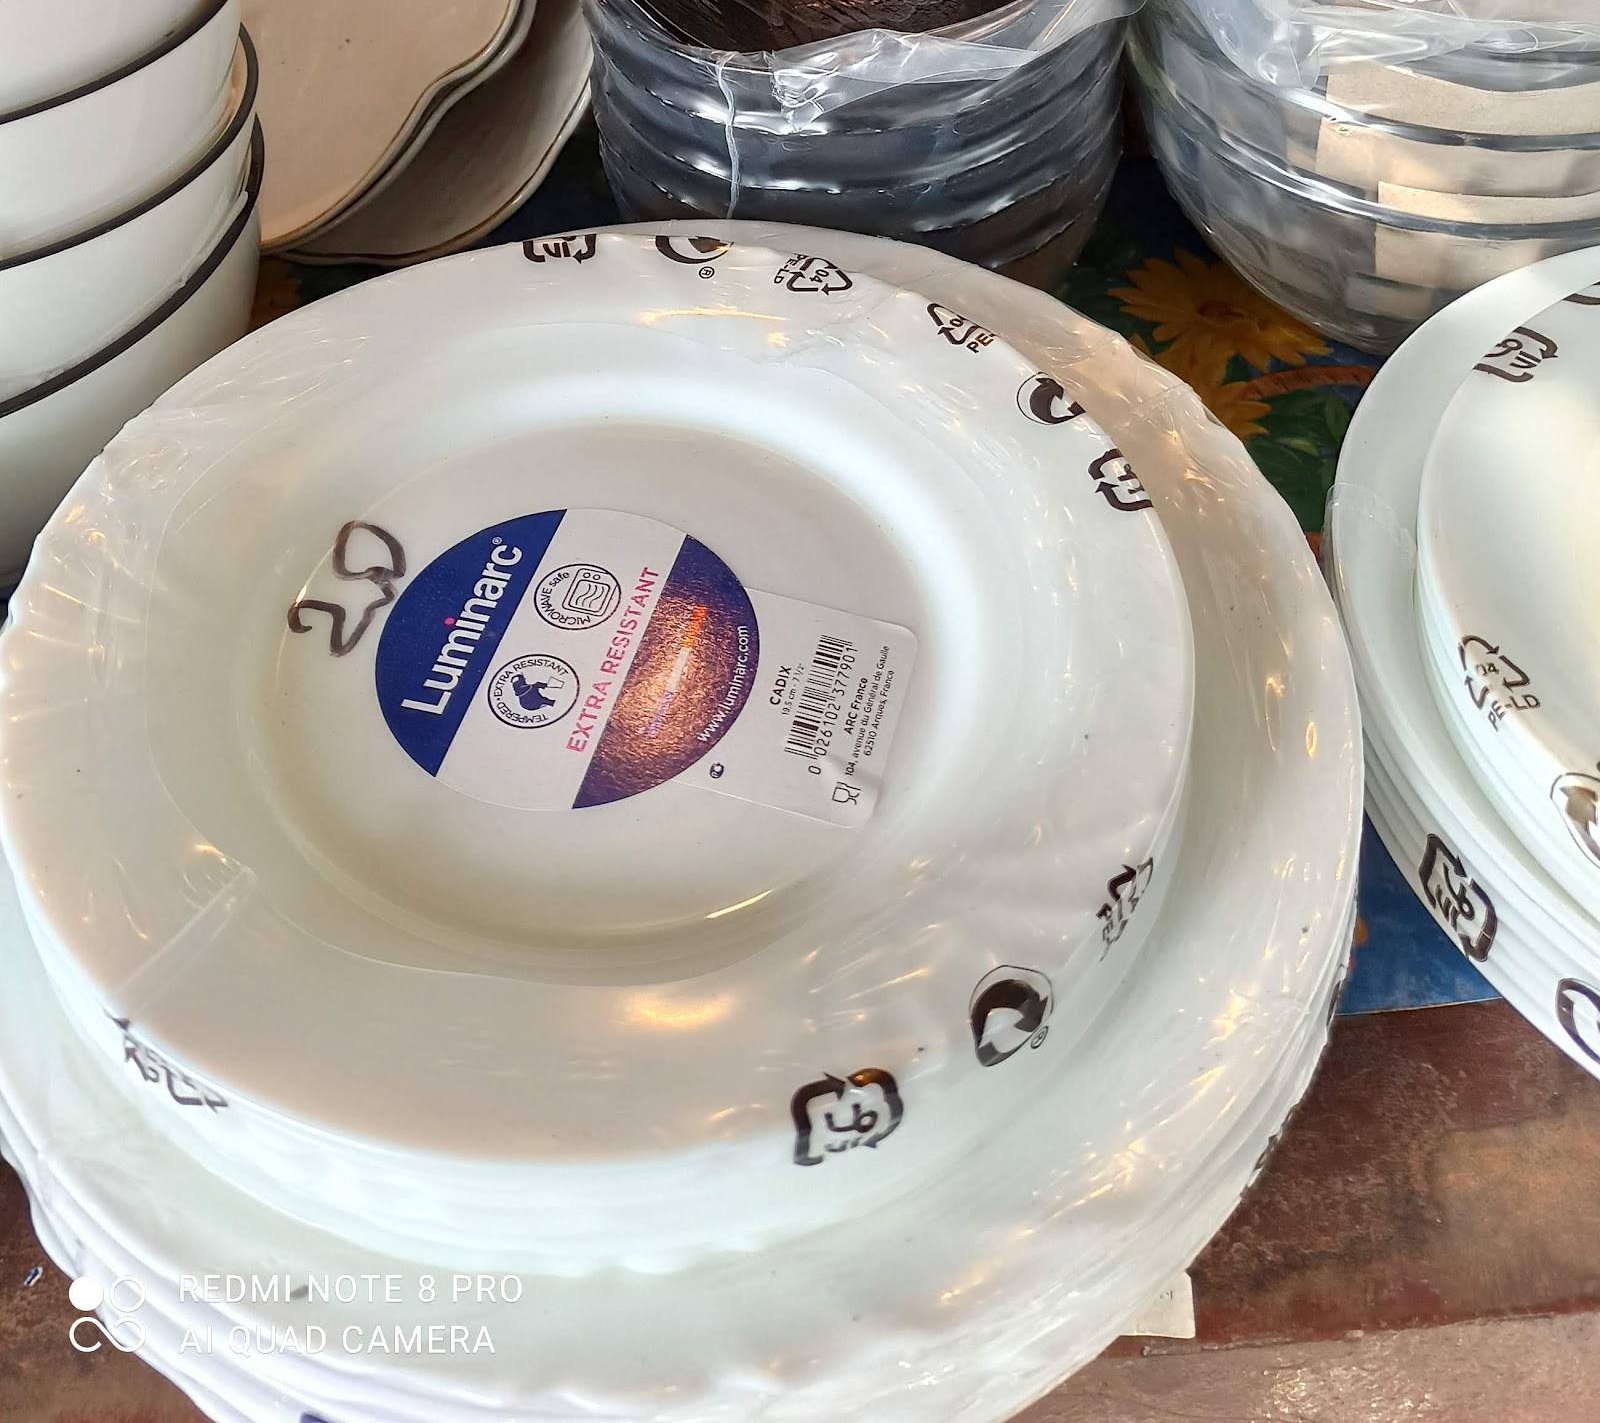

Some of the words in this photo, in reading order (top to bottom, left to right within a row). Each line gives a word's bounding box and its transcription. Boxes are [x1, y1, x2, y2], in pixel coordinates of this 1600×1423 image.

[288, 520, 406, 657] 20
[549, 572, 570, 587] safe
[540, 587, 591, 625] MICROWAVE
[513, 658, 569, 676] RESISTANT
[566, 681, 612, 754] EXTRA
[607, 566, 659, 676] RESISTANT
[831, 644, 858, 697] 377901
[698, 624, 748, 742] www.luminarc.com
[769, 663, 791, 706] CADIX
[850, 676, 868, 710] France
[851, 726, 866, 758] avenue
[875, 644, 890, 670] Gaulle
[496, 701, 549, 723] TEMPERED
[812, 701, 841, 757] 026102
[843, 711, 858, 735] ARC
[863, 730, 878, 756] 62510
[880, 669, 895, 697] France
[1488, 694, 1541, 731] PE-LD
[807, 764, 822, 775] 0
